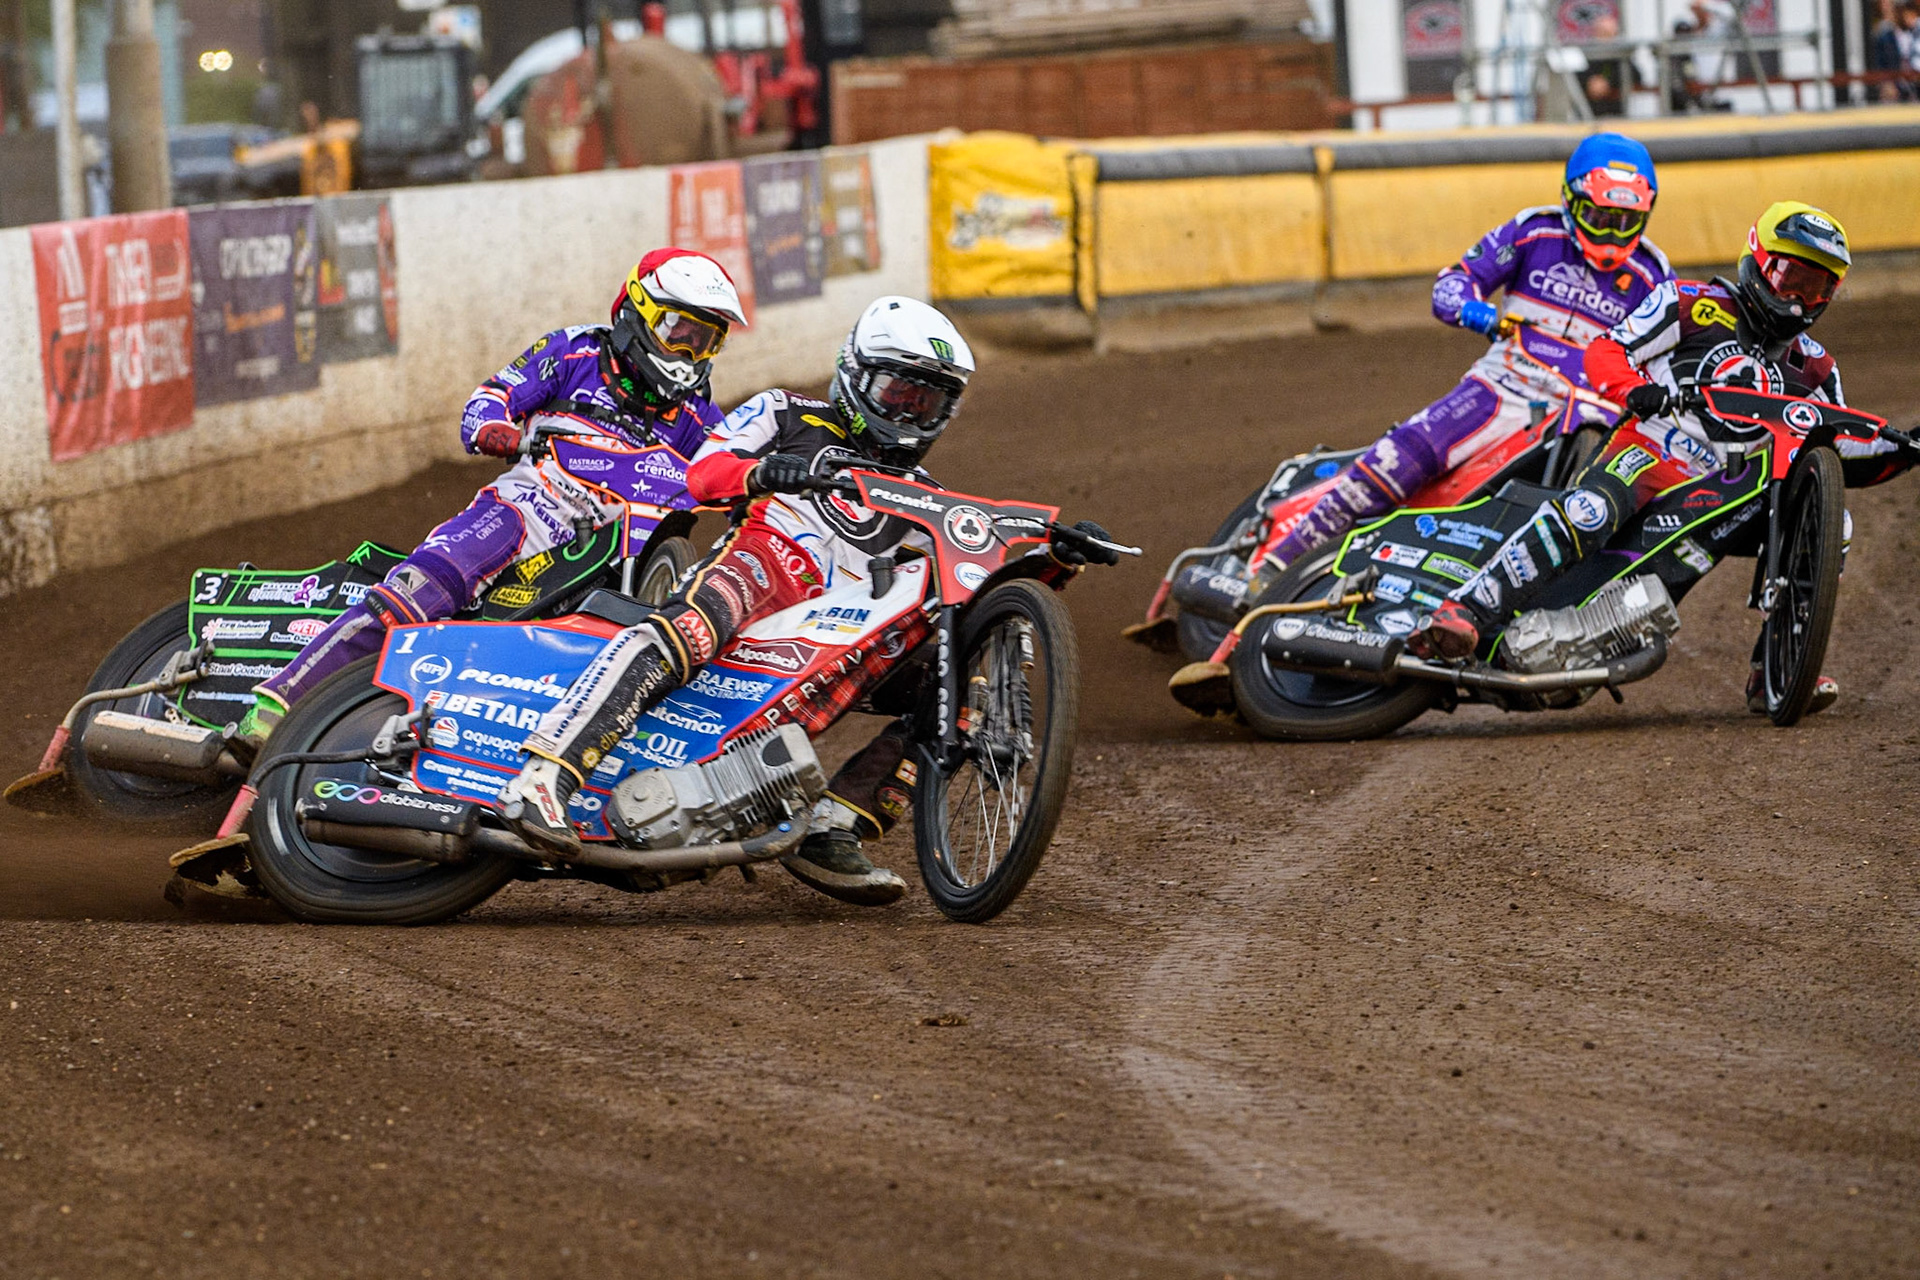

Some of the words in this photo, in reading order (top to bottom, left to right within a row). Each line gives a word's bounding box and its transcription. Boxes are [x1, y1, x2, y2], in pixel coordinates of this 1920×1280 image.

[1528, 269, 1627, 322] Crendon
[1711, 346, 1744, 364] BELLE
[568, 457, 605, 466] FASTRACK
[1578, 494, 1599, 522] ATPI
[475, 516, 504, 541] GROUP
[203, 577, 222, 600] 3
[500, 589, 536, 601] ASFALT
[395, 631, 419, 654] 1
[208, 662, 233, 676] Staal
[233, 663, 284, 678] Coaching
[415, 660, 447, 677] ATPI
[730, 647, 800, 670] Alpodach
[698, 669, 774, 695] RAJEWSKI
[553, 666, 608, 738] Henderson
[647, 732, 689, 760] OIL
[422, 759, 464, 777] Grant
